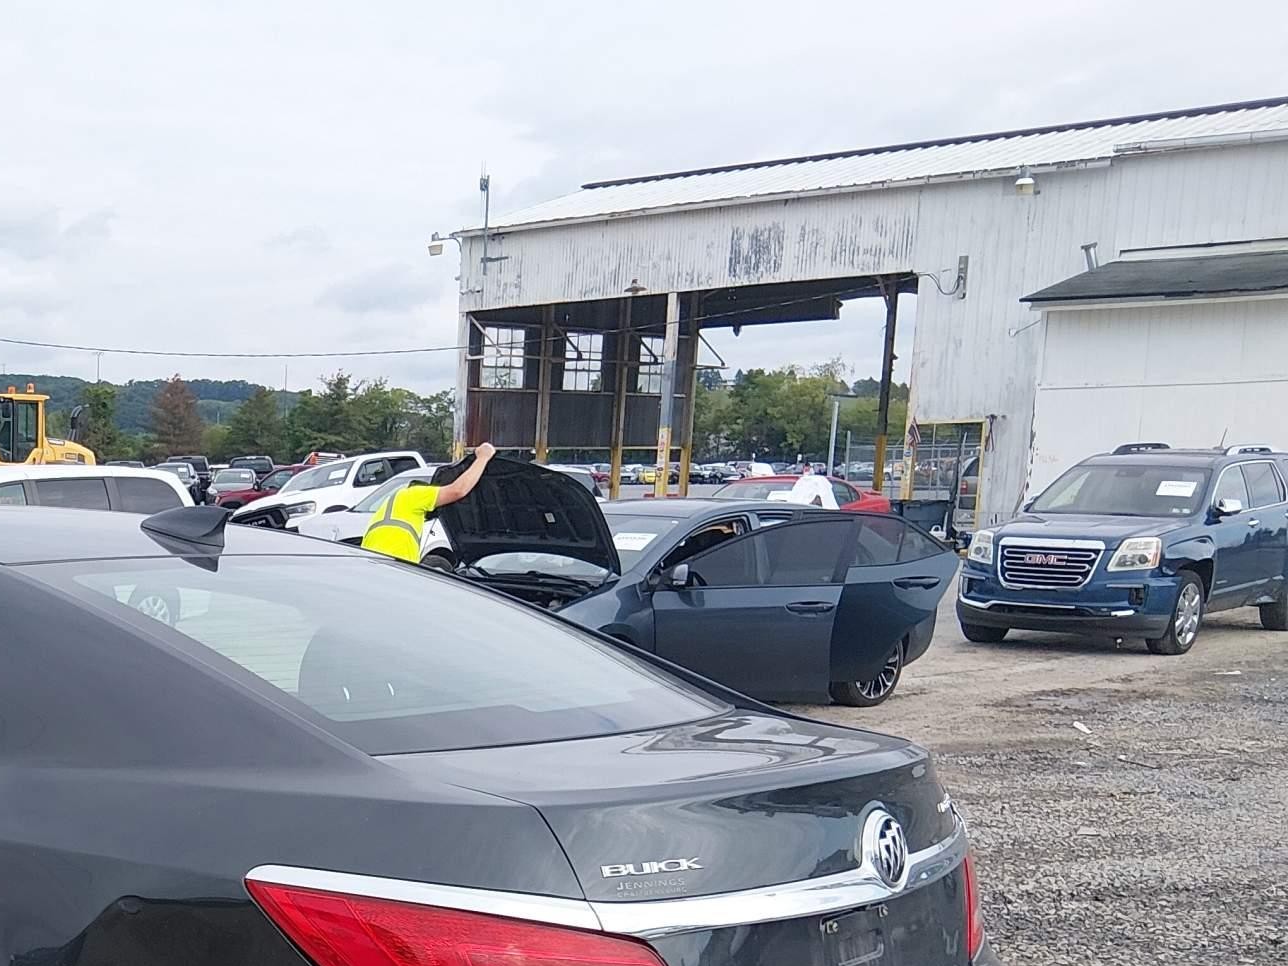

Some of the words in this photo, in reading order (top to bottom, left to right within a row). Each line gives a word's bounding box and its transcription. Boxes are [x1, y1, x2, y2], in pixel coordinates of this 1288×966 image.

[1024, 553, 1068, 566] GMC
[600, 856, 704, 878] BUICK
[616, 877, 686, 891] JENNINGS
